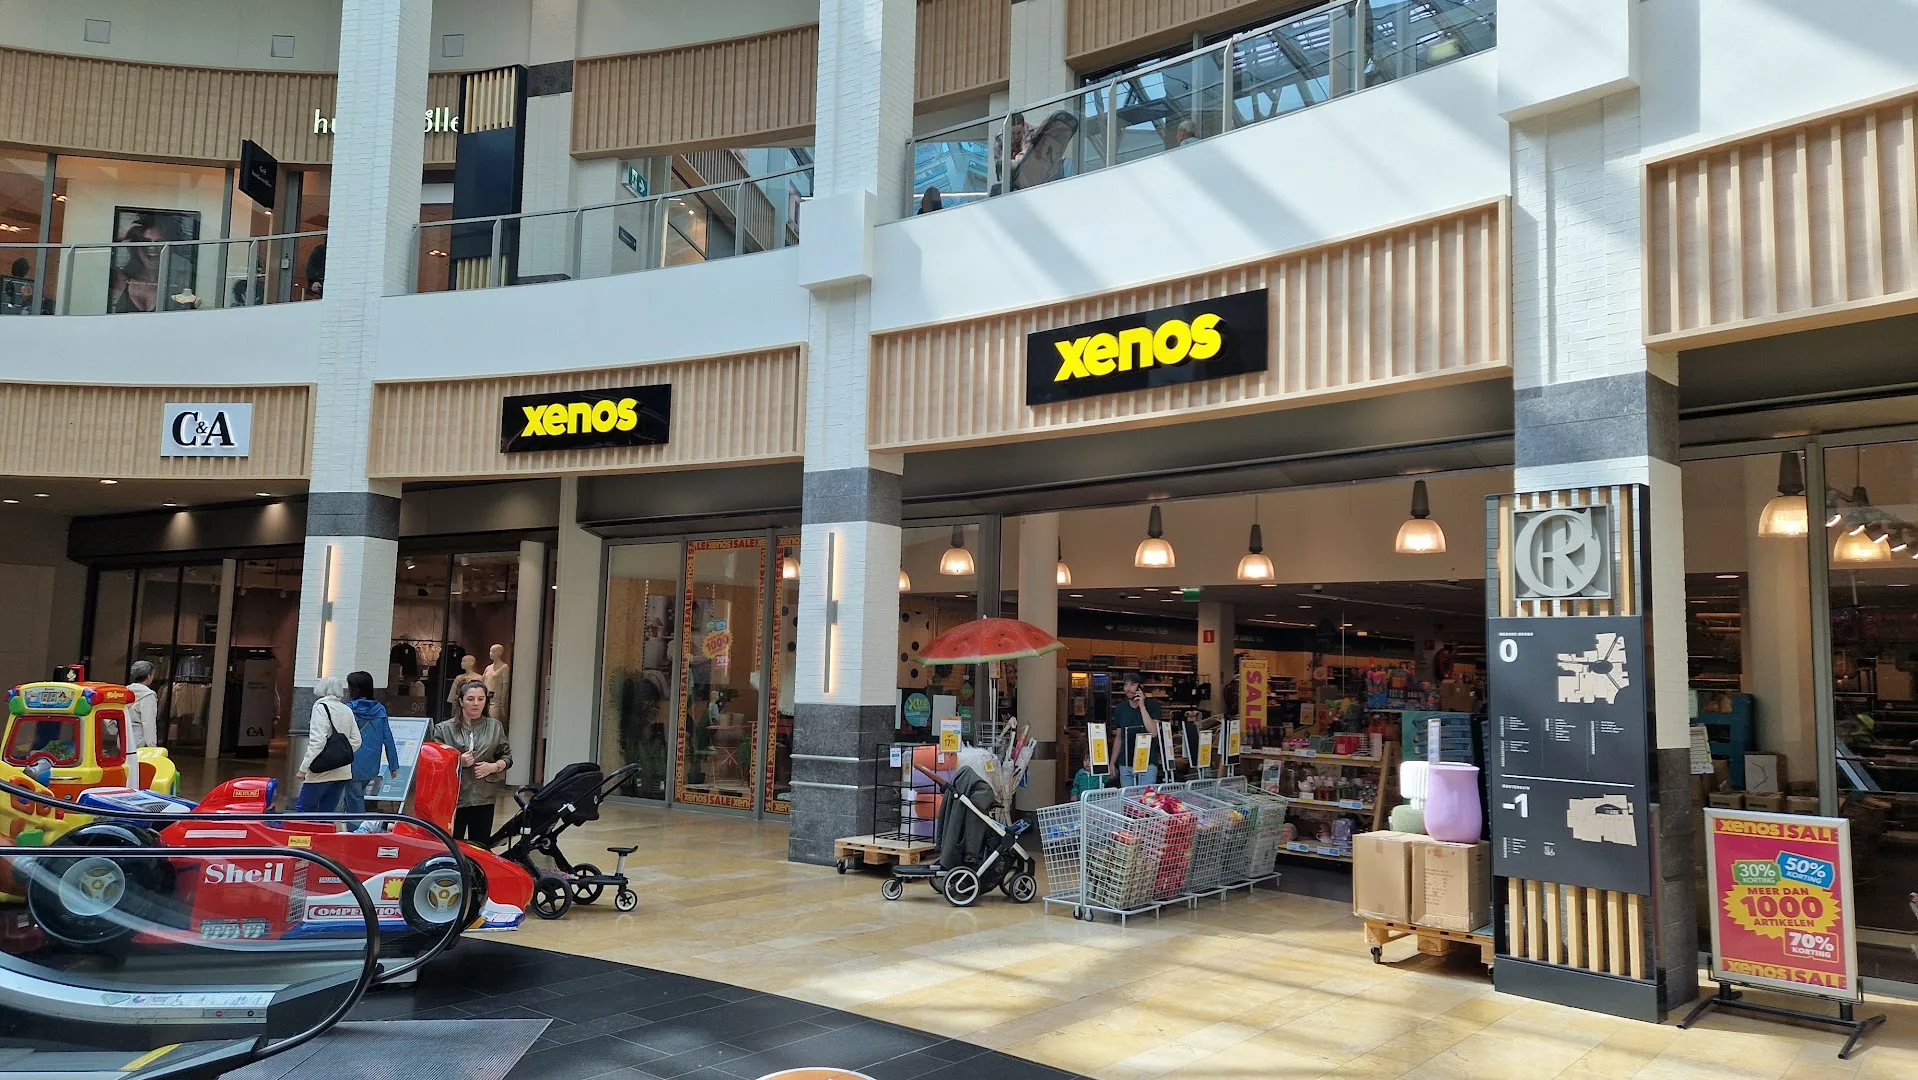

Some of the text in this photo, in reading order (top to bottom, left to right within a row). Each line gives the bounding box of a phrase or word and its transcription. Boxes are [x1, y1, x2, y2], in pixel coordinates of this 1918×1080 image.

[1054, 312, 1222, 382] xenos
[172, 411, 235, 447] C&A
[521, 398, 638, 437] xenos
[733, 538, 755, 549] SALE
[778, 536, 800, 546] xeno
[776, 547, 784, 578] SALE
[684, 594, 693, 624] SALE
[1500, 639, 1518, 663] 0
[770, 692, 778, 724] SALE
[677, 732, 685, 762] SALE
[766, 766, 774, 798] SALE
[683, 793, 708, 803] xenos
[709, 795, 731, 806] SALE
[1502, 793, 1528, 818] -1
[1720, 819, 1839, 842] xenos SALE
[1738, 863, 1776, 877] 30%
[1784, 856, 1827, 878] 50%
[1785, 870, 1822, 885] KORTING
[1747, 887, 1809, 895] MEER DAN
[1740, 895, 1824, 919] 1000
[1753, 918, 1815, 927] ARTIKELEN
[1788, 931, 1835, 952] 70%
[1791, 946, 1832, 958] KORTING
[1727, 960, 1847, 990] xenos SALE
